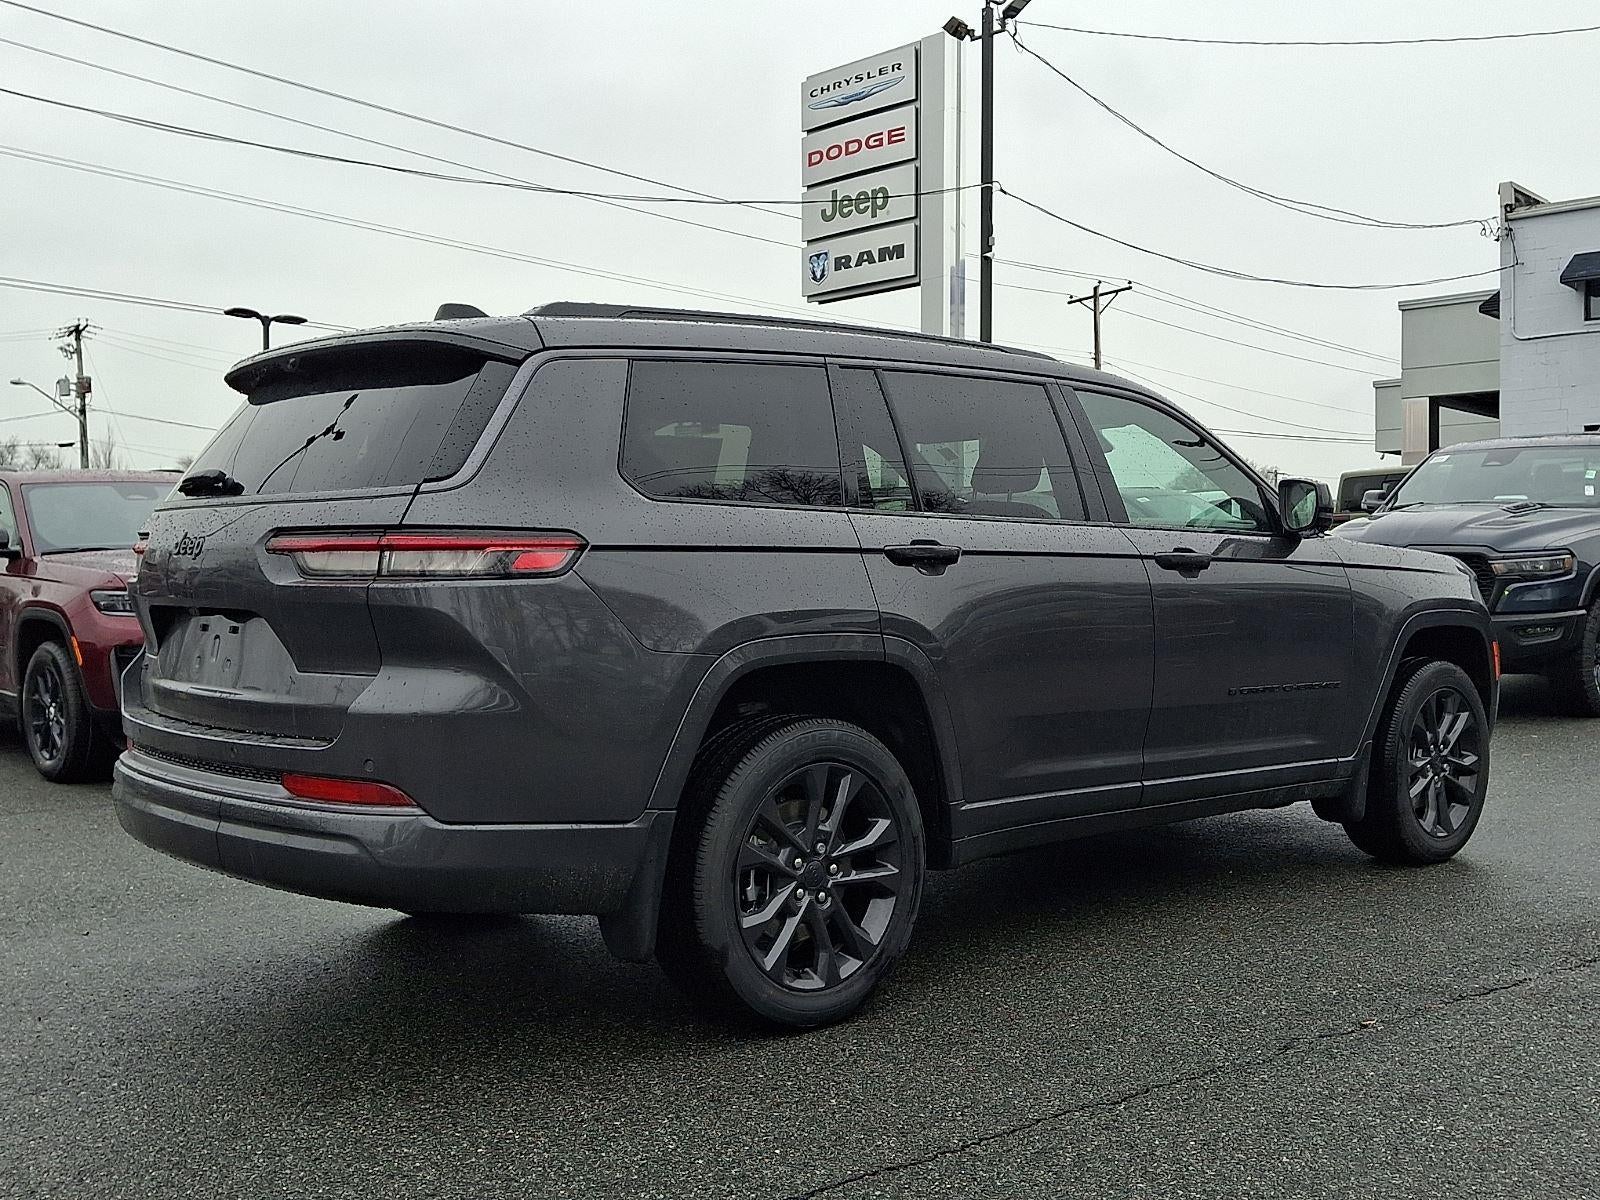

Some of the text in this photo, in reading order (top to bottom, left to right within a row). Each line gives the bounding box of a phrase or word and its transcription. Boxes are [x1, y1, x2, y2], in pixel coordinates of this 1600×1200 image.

[809, 62, 903, 98] CHRYSLER
[807, 126, 906, 168] DODGE
[820, 186, 890, 223] Jeep
[833, 243, 905, 272] RAM
[173, 532, 205, 560] Jeep
